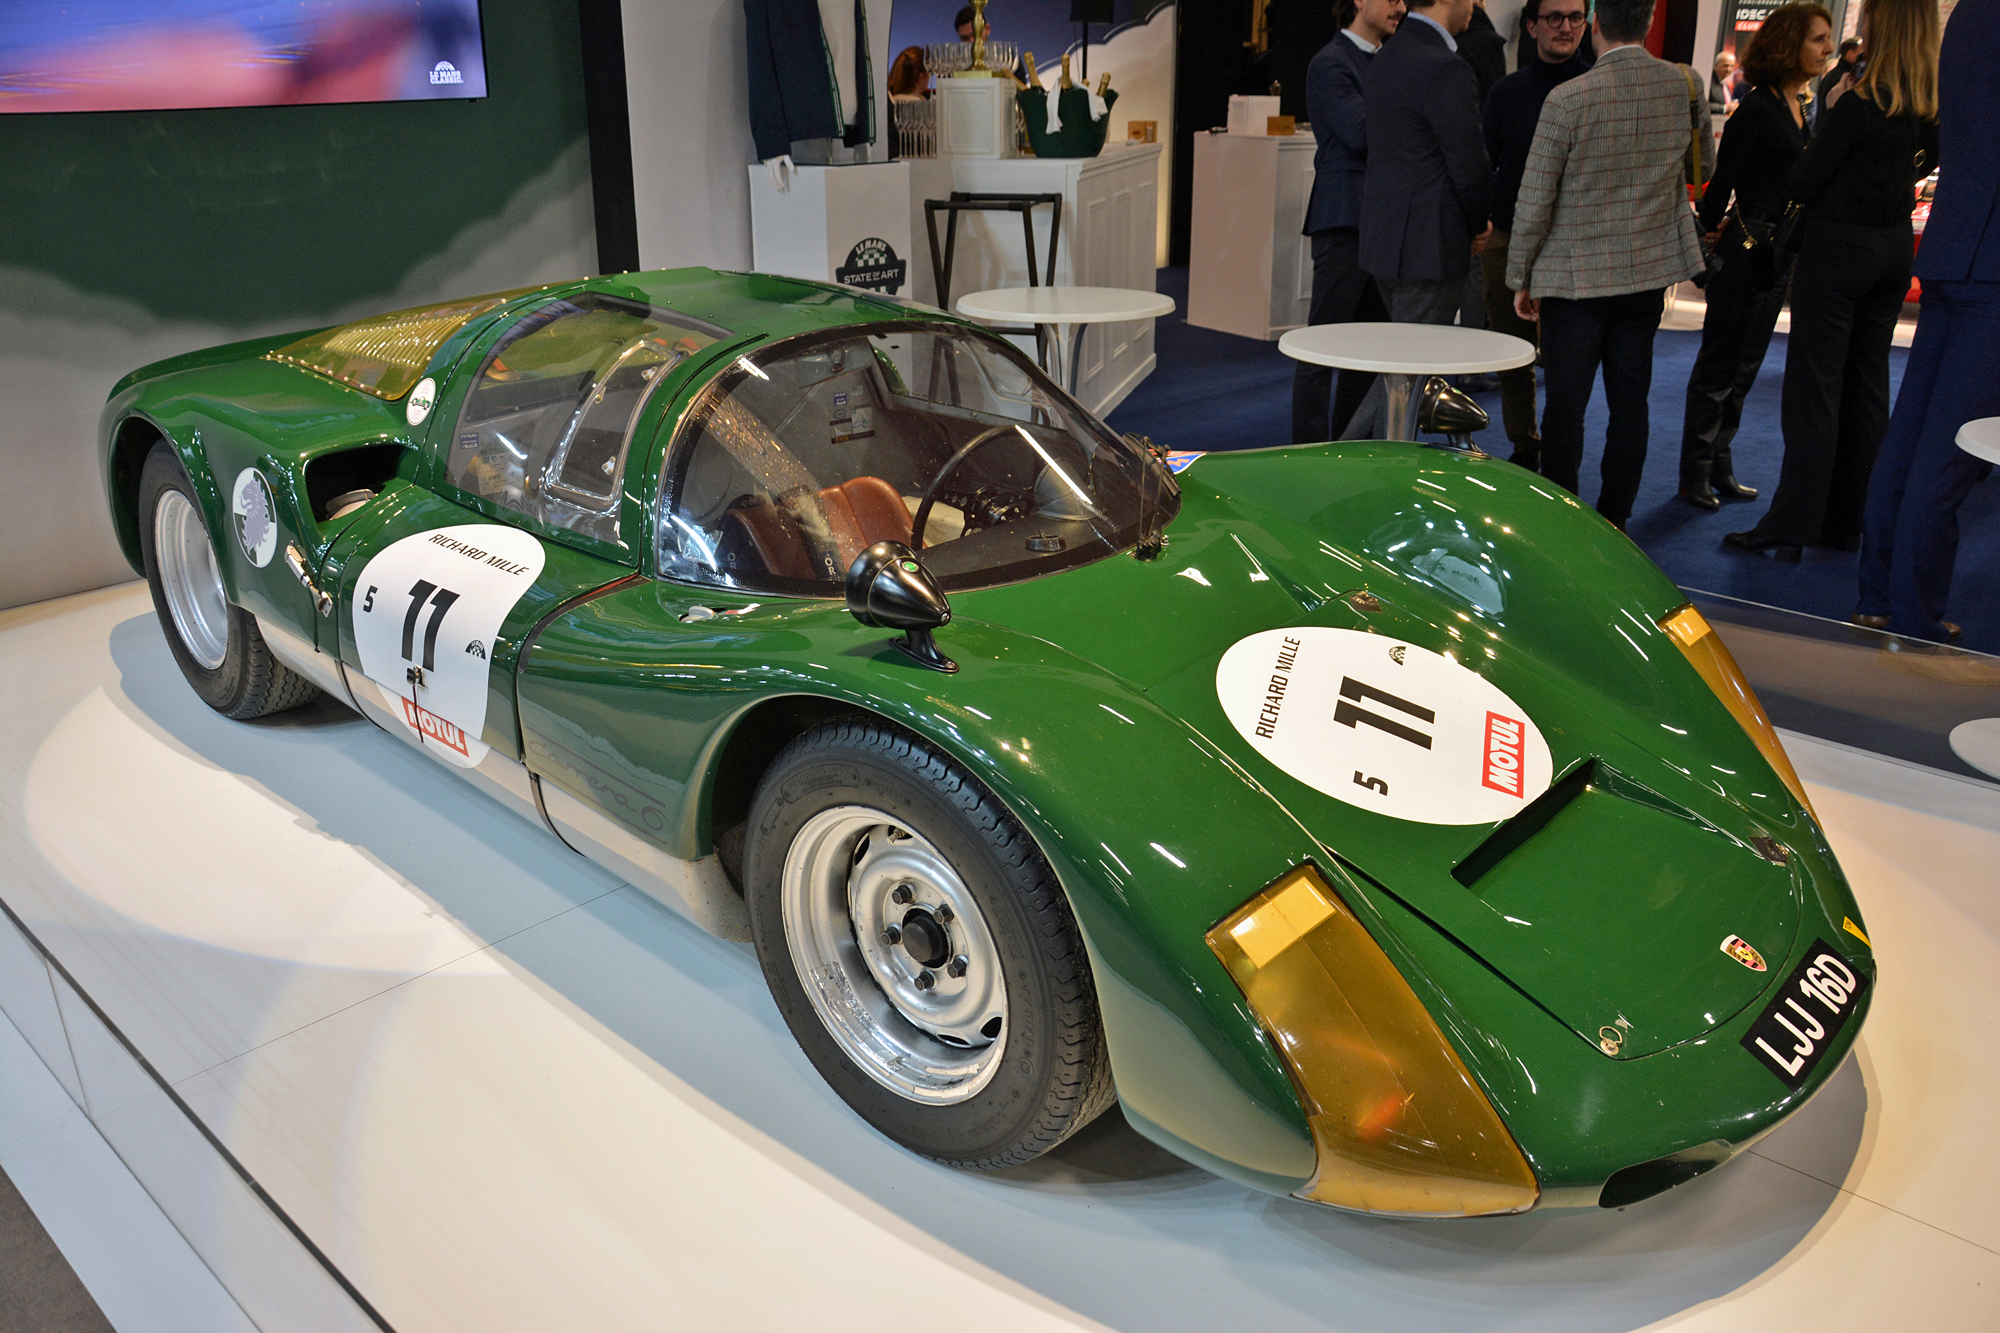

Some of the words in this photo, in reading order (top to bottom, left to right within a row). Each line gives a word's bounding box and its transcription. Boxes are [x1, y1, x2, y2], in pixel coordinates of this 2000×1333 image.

[1735, 8, 1767, 20] IDEC
[856, 243, 865, 255] LE
[865, 240, 887, 252] MANS
[844, 272, 871, 285] STATE
[881, 268, 899, 280] ART
[428, 533, 488, 561] RICHARD
[483, 555, 530, 576] MILLE
[363, 585, 378, 613] 5
[401, 578, 461, 673] 11
[1255, 674, 1288, 739] RICHARD
[1275, 636, 1300, 673] MILLE
[407, 703, 464, 751] MOTUL
[1333, 675, 1435, 751] 11
[1488, 718, 1519, 793] MOTUL
[528, 740, 637, 812] Carrera
[641, 805, 666, 831] 6
[1353, 770, 1388, 796] 5
[1754, 997, 1825, 1077] LJJ
[1799, 954, 1857, 1015] 16D
